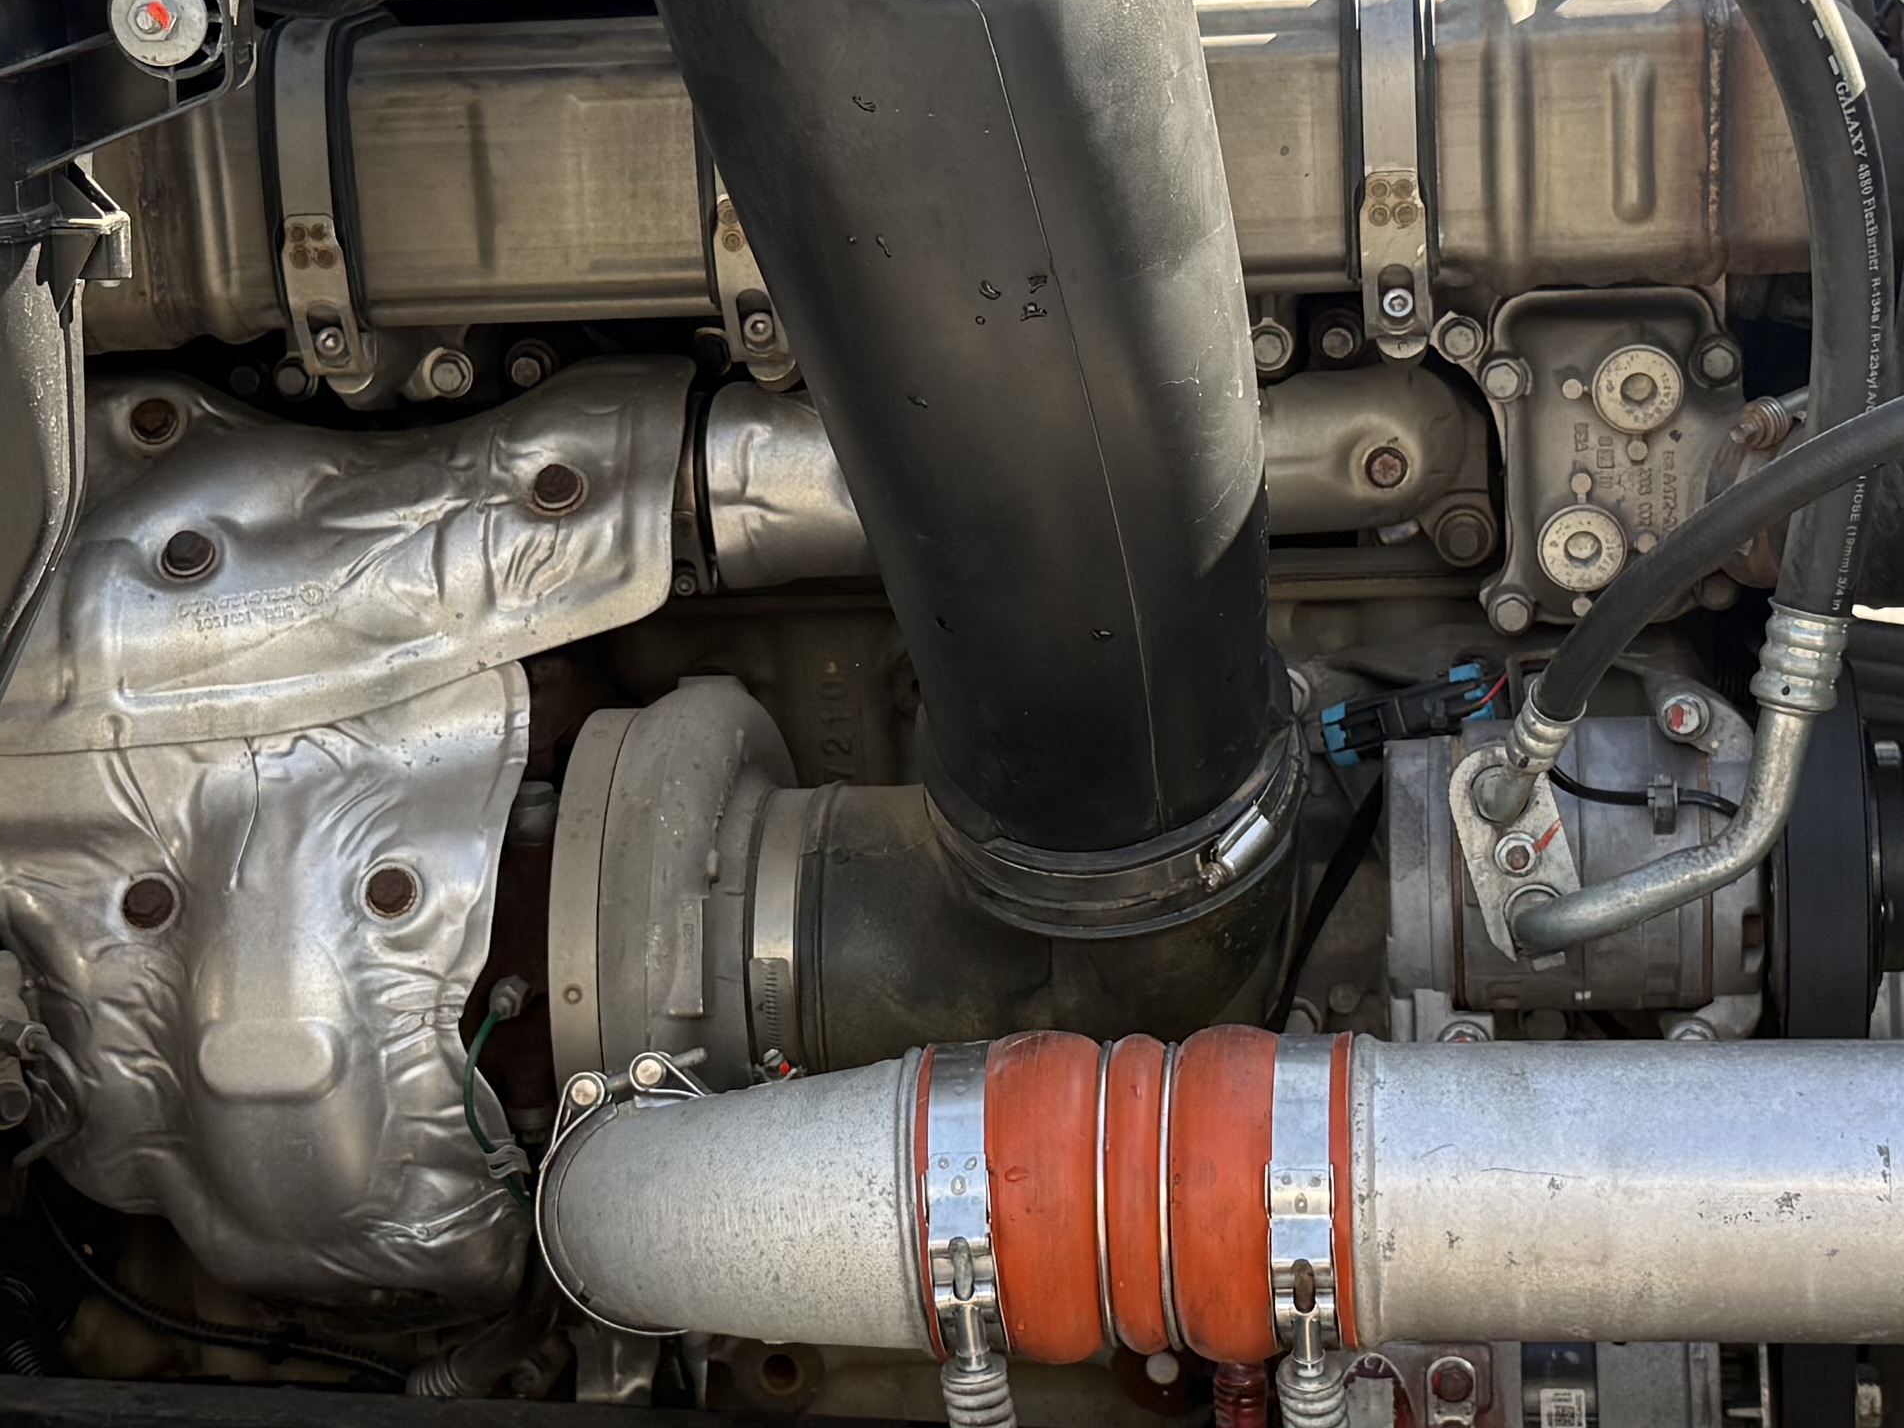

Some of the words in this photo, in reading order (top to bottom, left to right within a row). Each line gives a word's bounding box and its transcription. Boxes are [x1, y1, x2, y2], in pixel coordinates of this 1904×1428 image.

[1835, 80, 1867, 158] GALAXY
[1857, 162, 1874, 196] 4880
[1862, 196, 1882, 272] FlexBarrier
[1870, 277, 1882, 322] R-134a
[1850, 483, 1865, 521] HOSE
